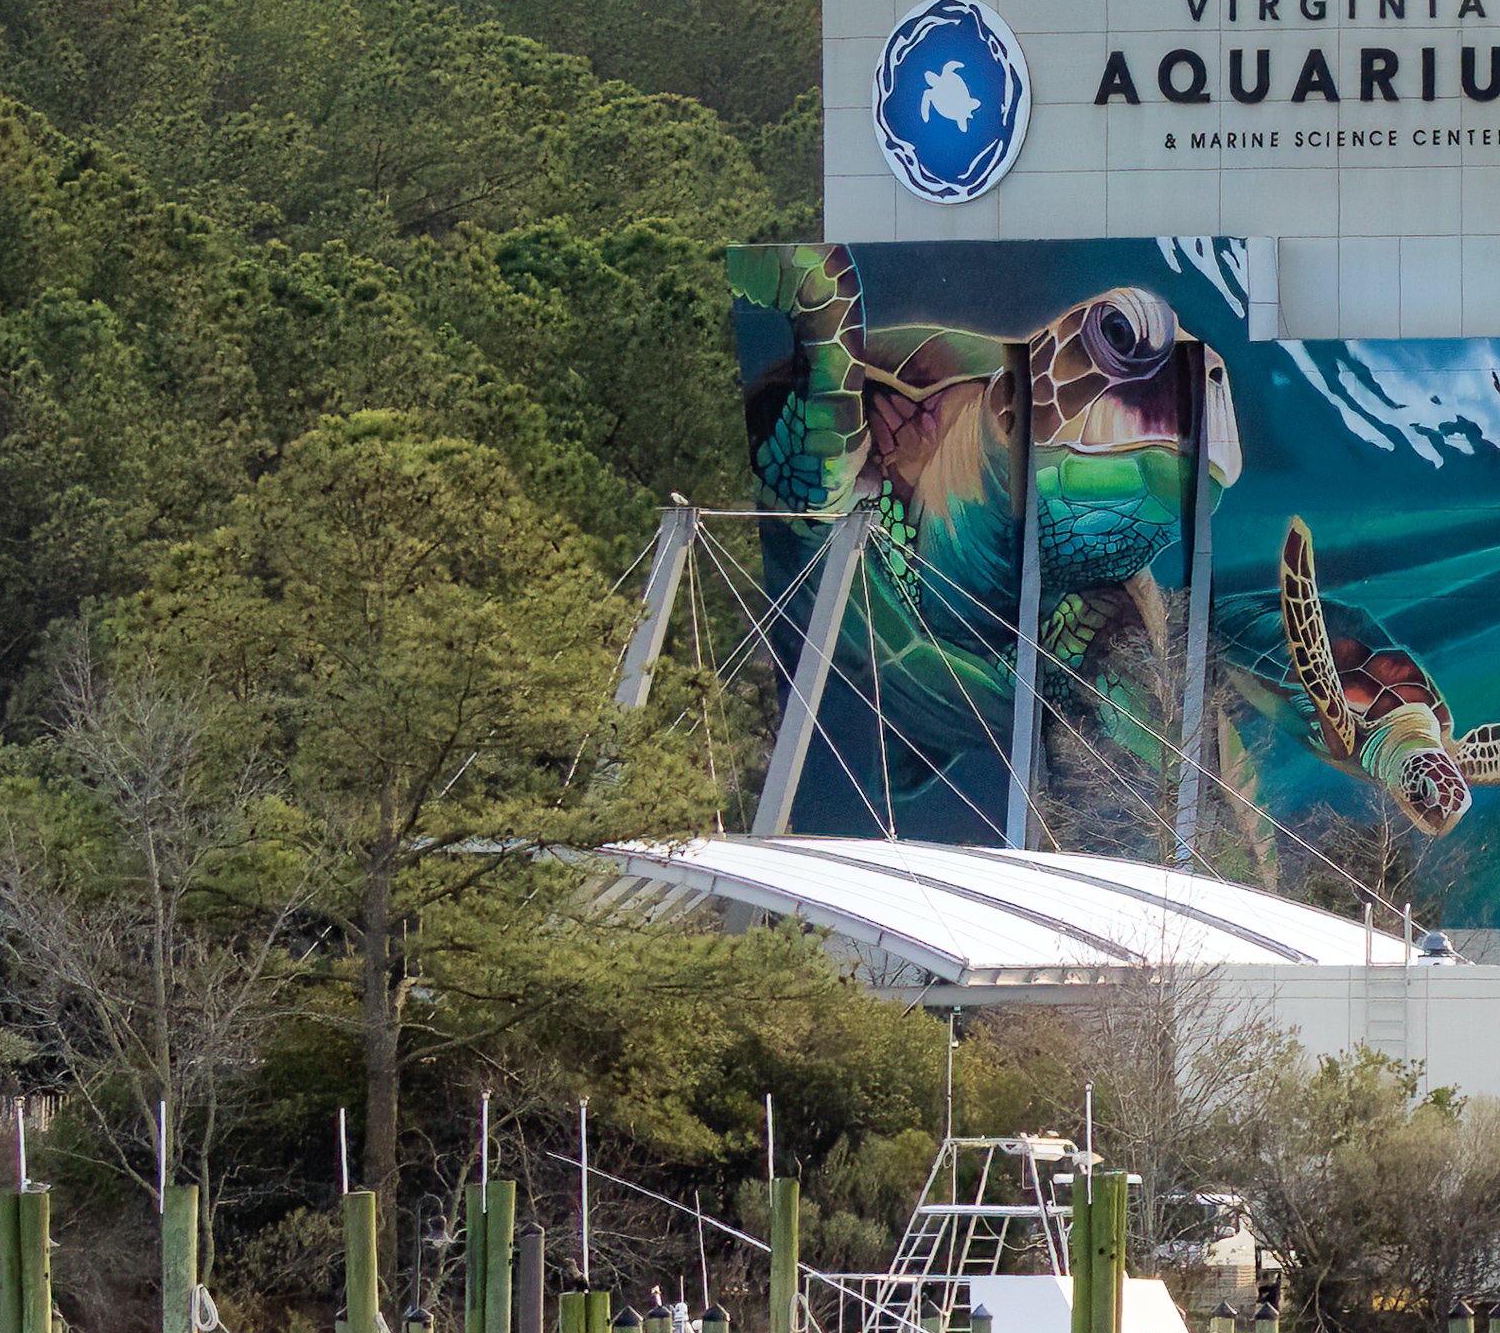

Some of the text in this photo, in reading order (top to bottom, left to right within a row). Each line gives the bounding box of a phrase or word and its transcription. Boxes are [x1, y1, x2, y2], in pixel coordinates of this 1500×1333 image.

[1164, 133, 1177, 149] &
[1191, 131, 1279, 149] MARINE
[1295, 130, 1397, 148] SCIENCE
